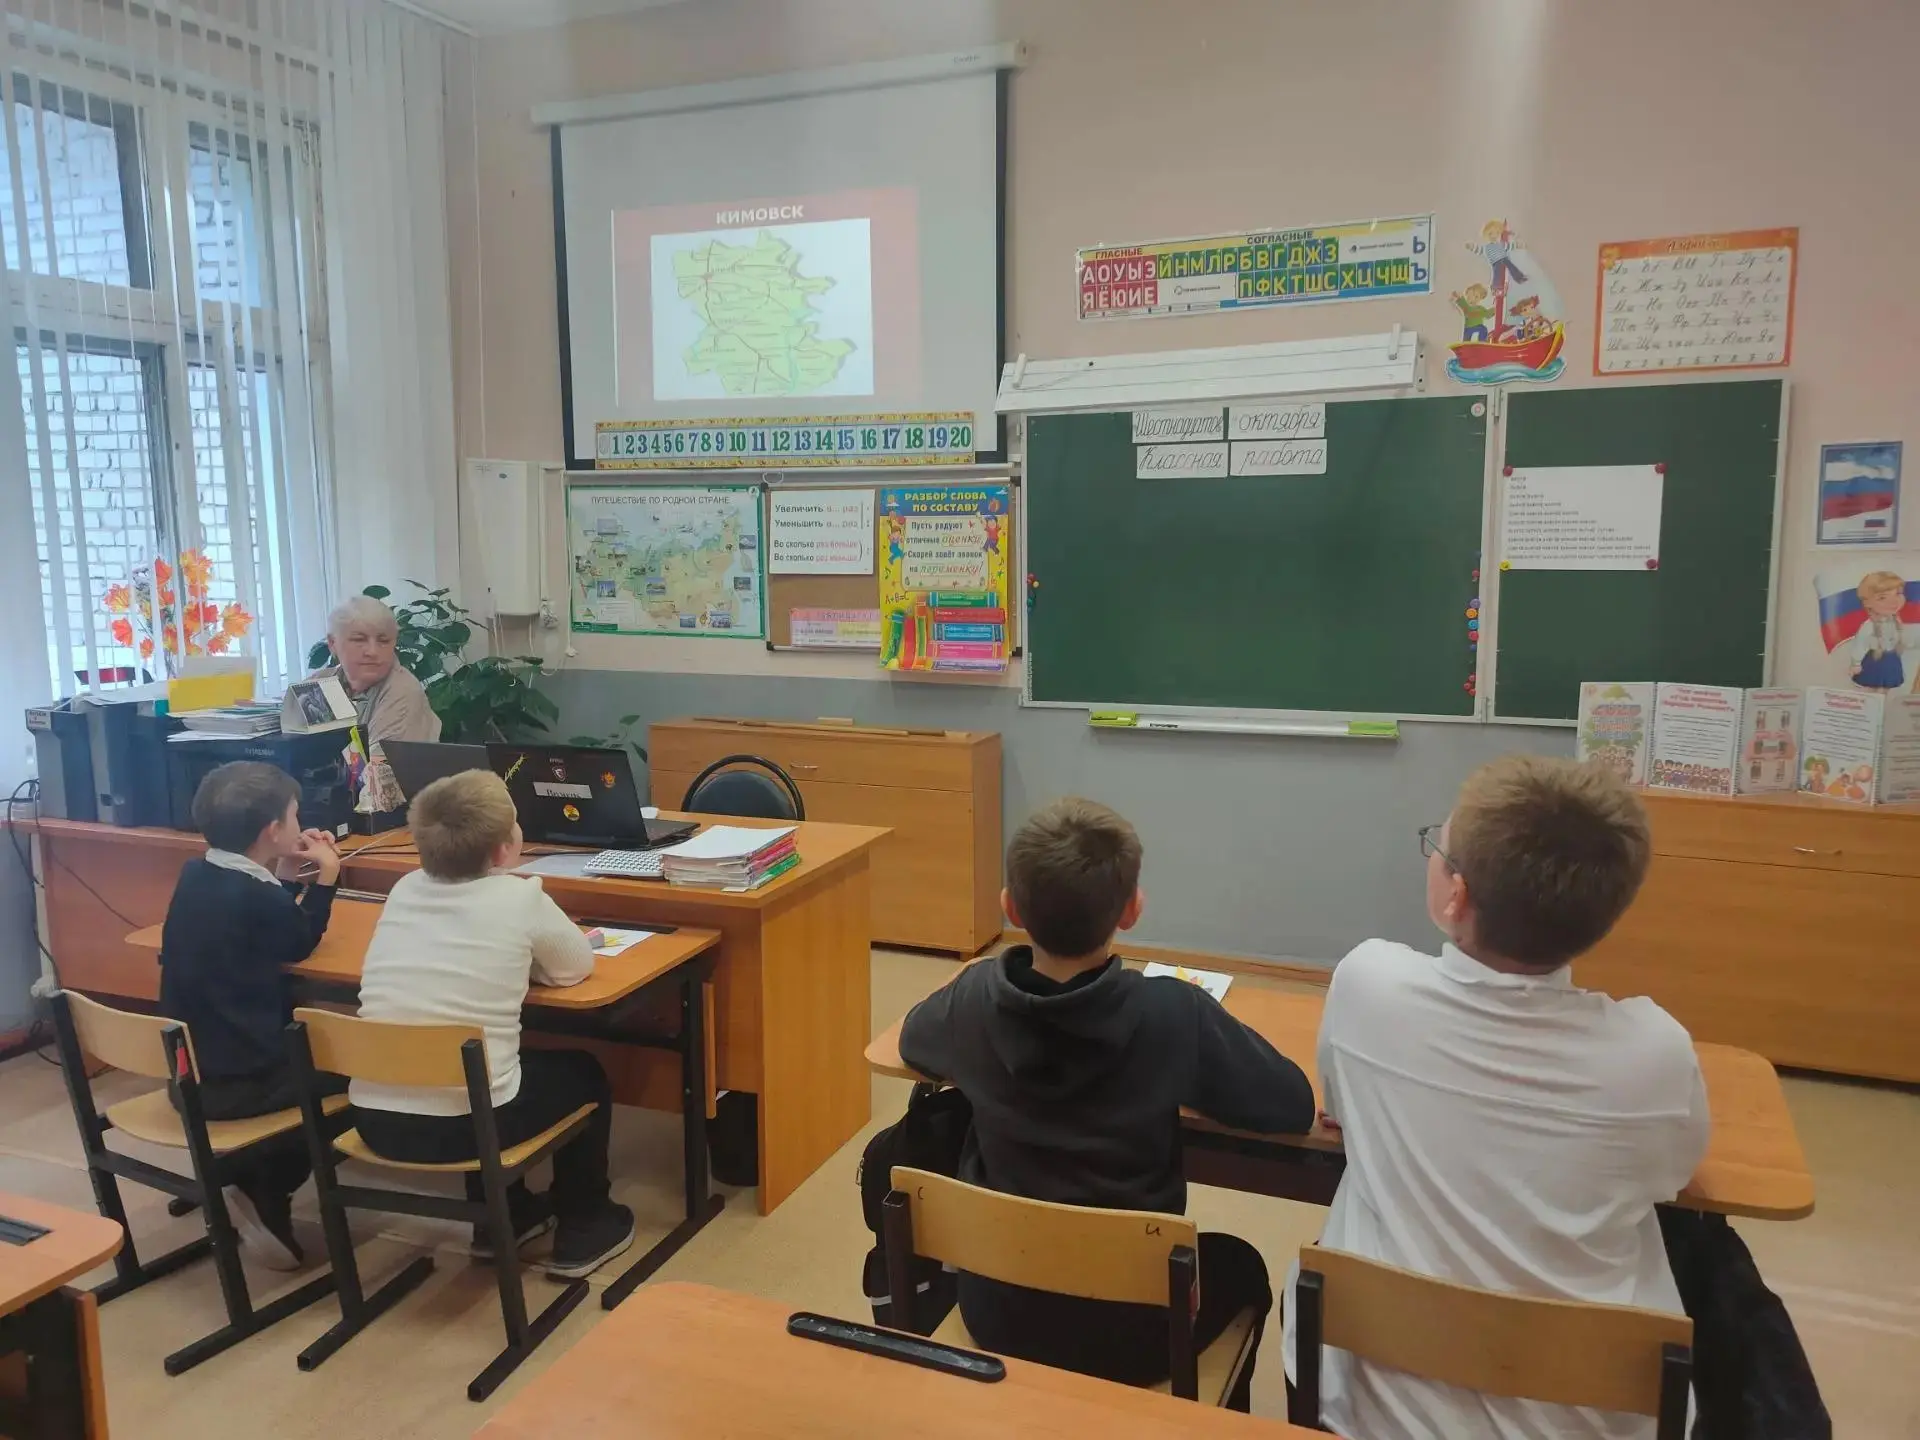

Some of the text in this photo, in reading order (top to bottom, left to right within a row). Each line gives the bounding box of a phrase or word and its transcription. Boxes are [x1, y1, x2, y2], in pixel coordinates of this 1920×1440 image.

[716, 204, 804, 224] КИМОВСК
[1247, 230, 1313, 245] СОГЛАСНЫЕ
[1095, 247, 1143, 259] ГЛАСНЫЕ
[613, 435, 620, 454] 1
[626, 435, 635, 454] 2
[638, 433, 647, 453] 3
[651, 434, 660, 453] 4
[664, 434, 672, 452] 5
[675, 433, 684, 452] 6
[689, 433, 698, 452] 7
[701, 432, 711, 451] 8
[716, 432, 724, 451] 9
[729, 432, 746, 451] 10
[752, 431, 766, 451] 11
[772, 431, 790, 451] 12
[794, 430, 811, 450] 13
[815, 430, 833, 450] 14
[838, 430, 854, 449] 15
[860, 429, 877, 449] 16
[882, 429, 900, 449] 17
[905, 428, 924, 448] 18
[928, 427, 947, 448] 19
[950, 426, 971, 447] 20
[1138, 441, 1323, 474] Классная работа
[591, 496, 729, 506] ПУТЕШЕСТВИЕ ПО РОДНОЙ СТРАНЕ
[905, 492, 986, 501] РАЗБОР СЛОВА
[913, 504, 978, 512] ПО СОСТАВУ
[912, 522, 962, 530] Пусть радуют
[908, 550, 933, 559] Скорей
